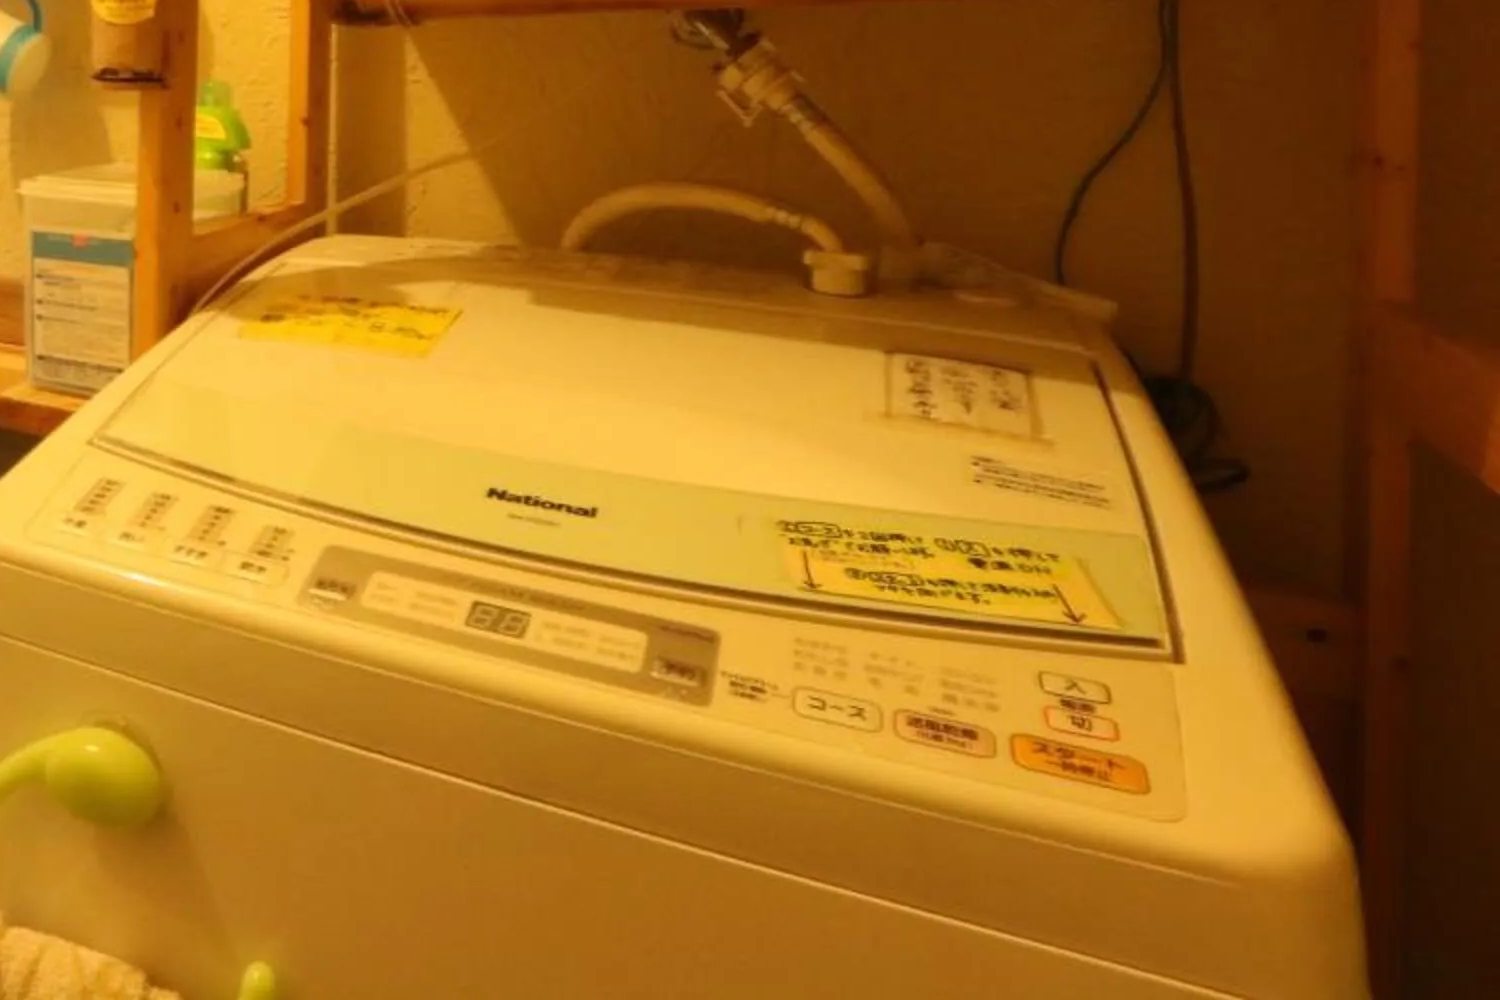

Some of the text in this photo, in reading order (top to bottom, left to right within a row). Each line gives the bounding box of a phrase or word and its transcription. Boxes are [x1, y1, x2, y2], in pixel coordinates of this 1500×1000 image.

[486, 487, 598, 518] National
[807, 695, 869, 721] コース
[1031, 740, 1127, 771] スタート
